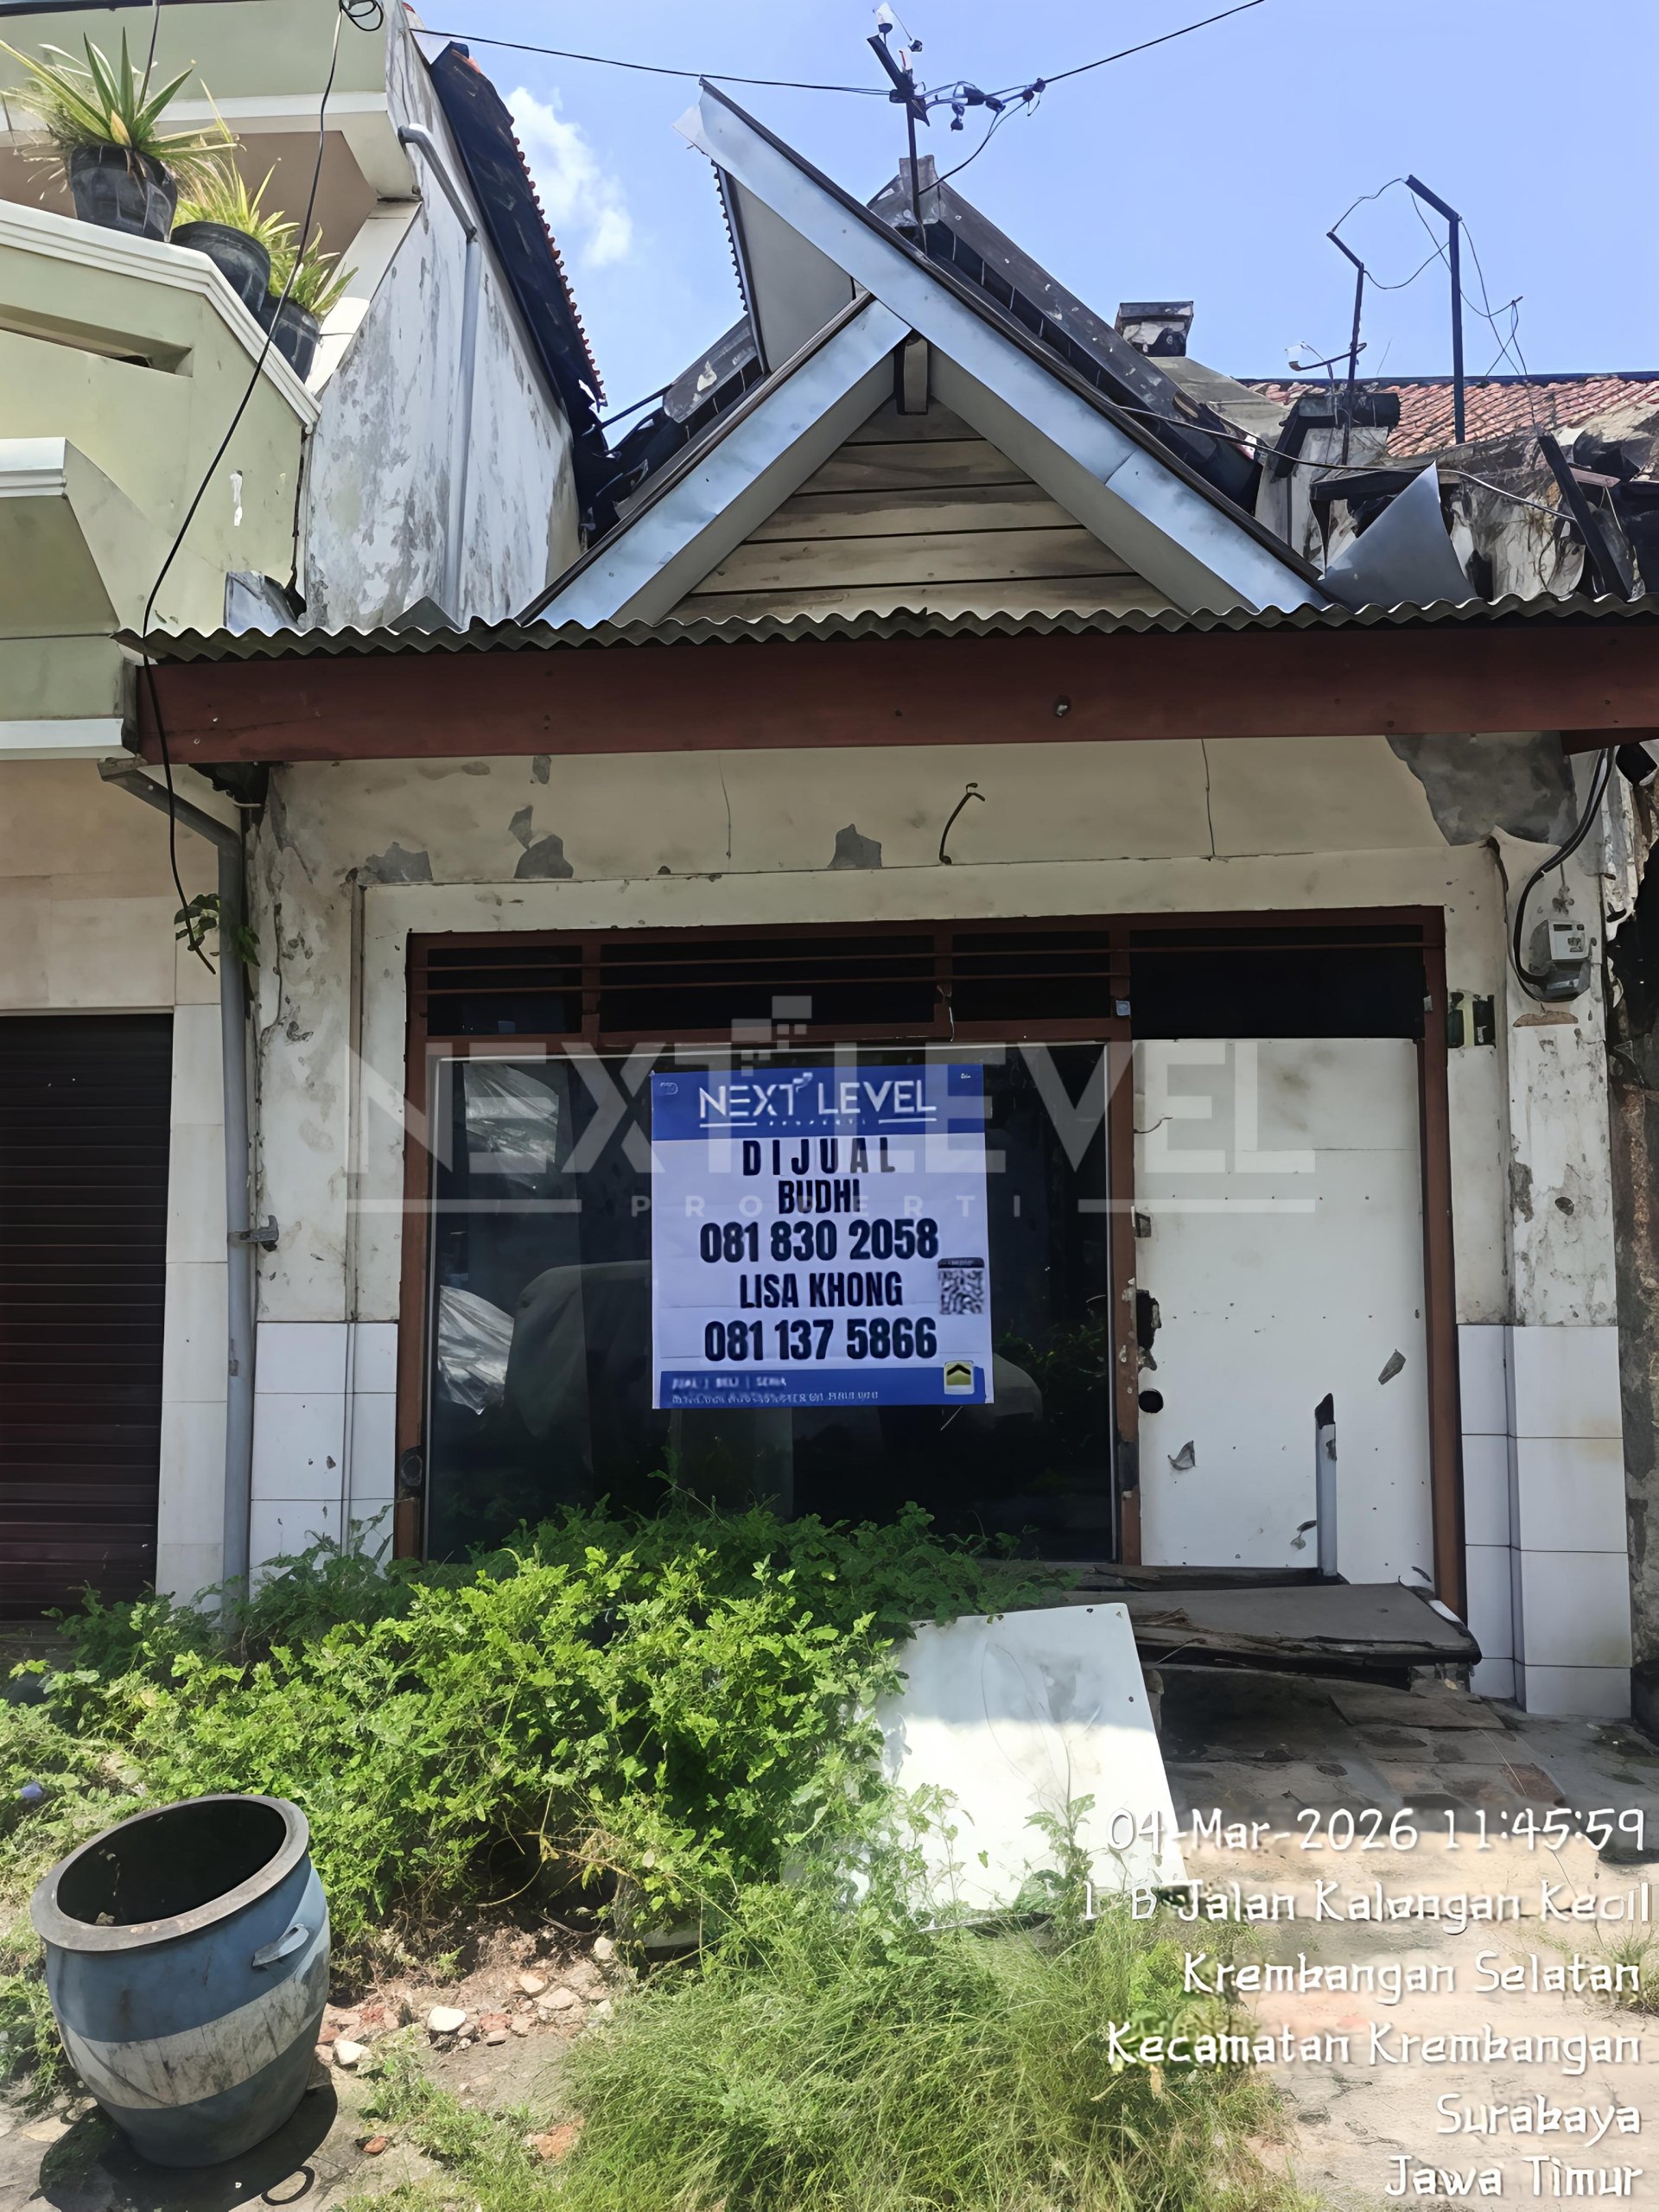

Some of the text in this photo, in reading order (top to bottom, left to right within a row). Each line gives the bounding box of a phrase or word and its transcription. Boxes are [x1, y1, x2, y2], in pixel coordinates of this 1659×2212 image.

[699, 1079, 938, 1118] NEXT LEVEL
[778, 1179, 861, 1215] BUDHI
[699, 1217, 938, 1263] 081 830 2058
[740, 1271, 904, 1309] LISA KHONG
[703, 1317, 938, 1362] 081 137 5866
